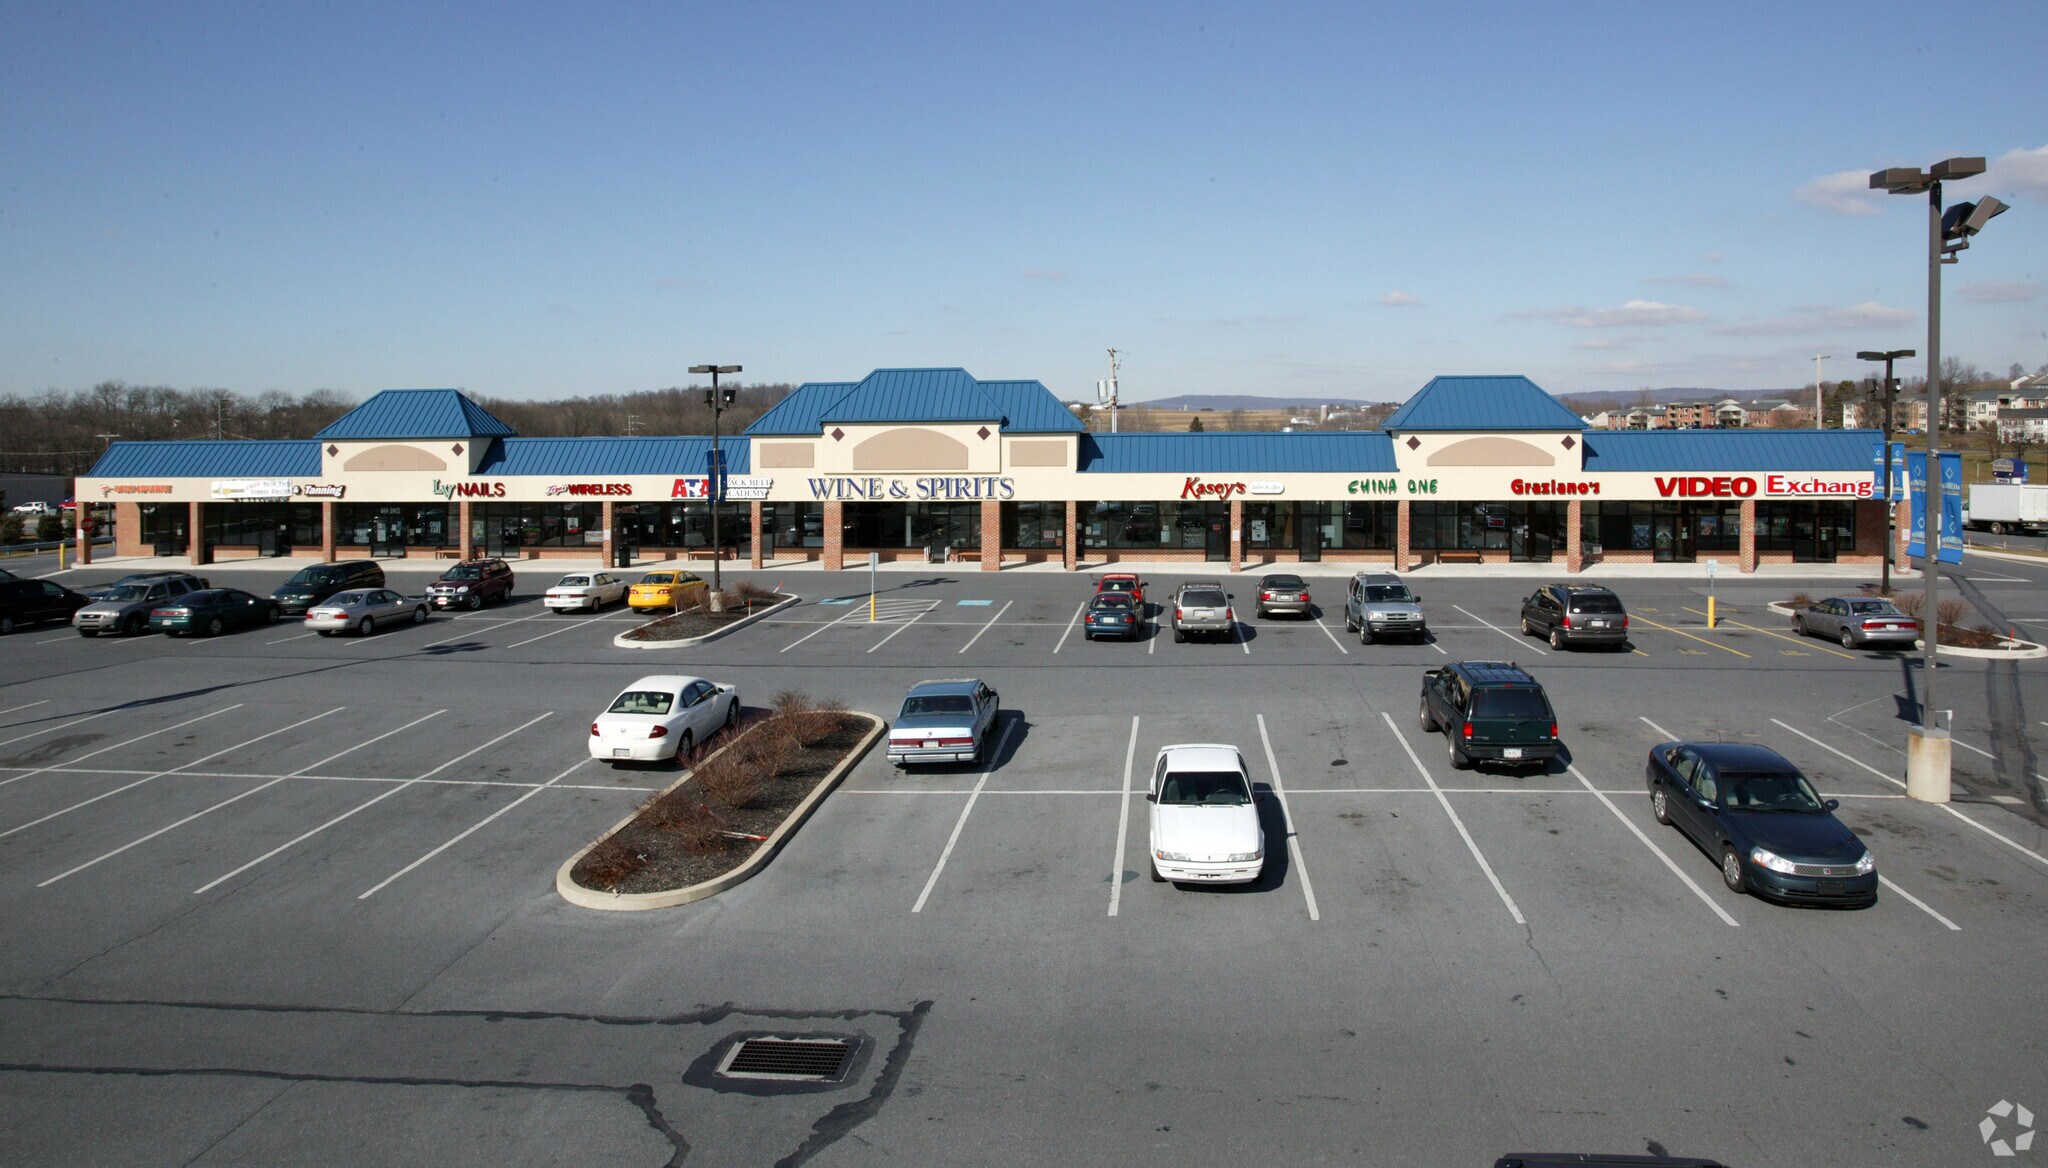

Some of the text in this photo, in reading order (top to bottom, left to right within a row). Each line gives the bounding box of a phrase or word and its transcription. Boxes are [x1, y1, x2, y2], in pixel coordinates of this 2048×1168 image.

[304, 484, 345, 498] Tanning
[457, 482, 506, 497] NAILS
[568, 483, 632, 496] WIRELESS
[749, 479, 771, 487] BELT
[807, 476, 1015, 500] WINE & SPIRITS
[1181, 476, 1247, 500] Kasey's
[1348, 478, 1439, 495] CHINA ONE
[1511, 478, 1601, 495] Graziano's
[1654, 475, 1874, 498] VIDEO Exchang
